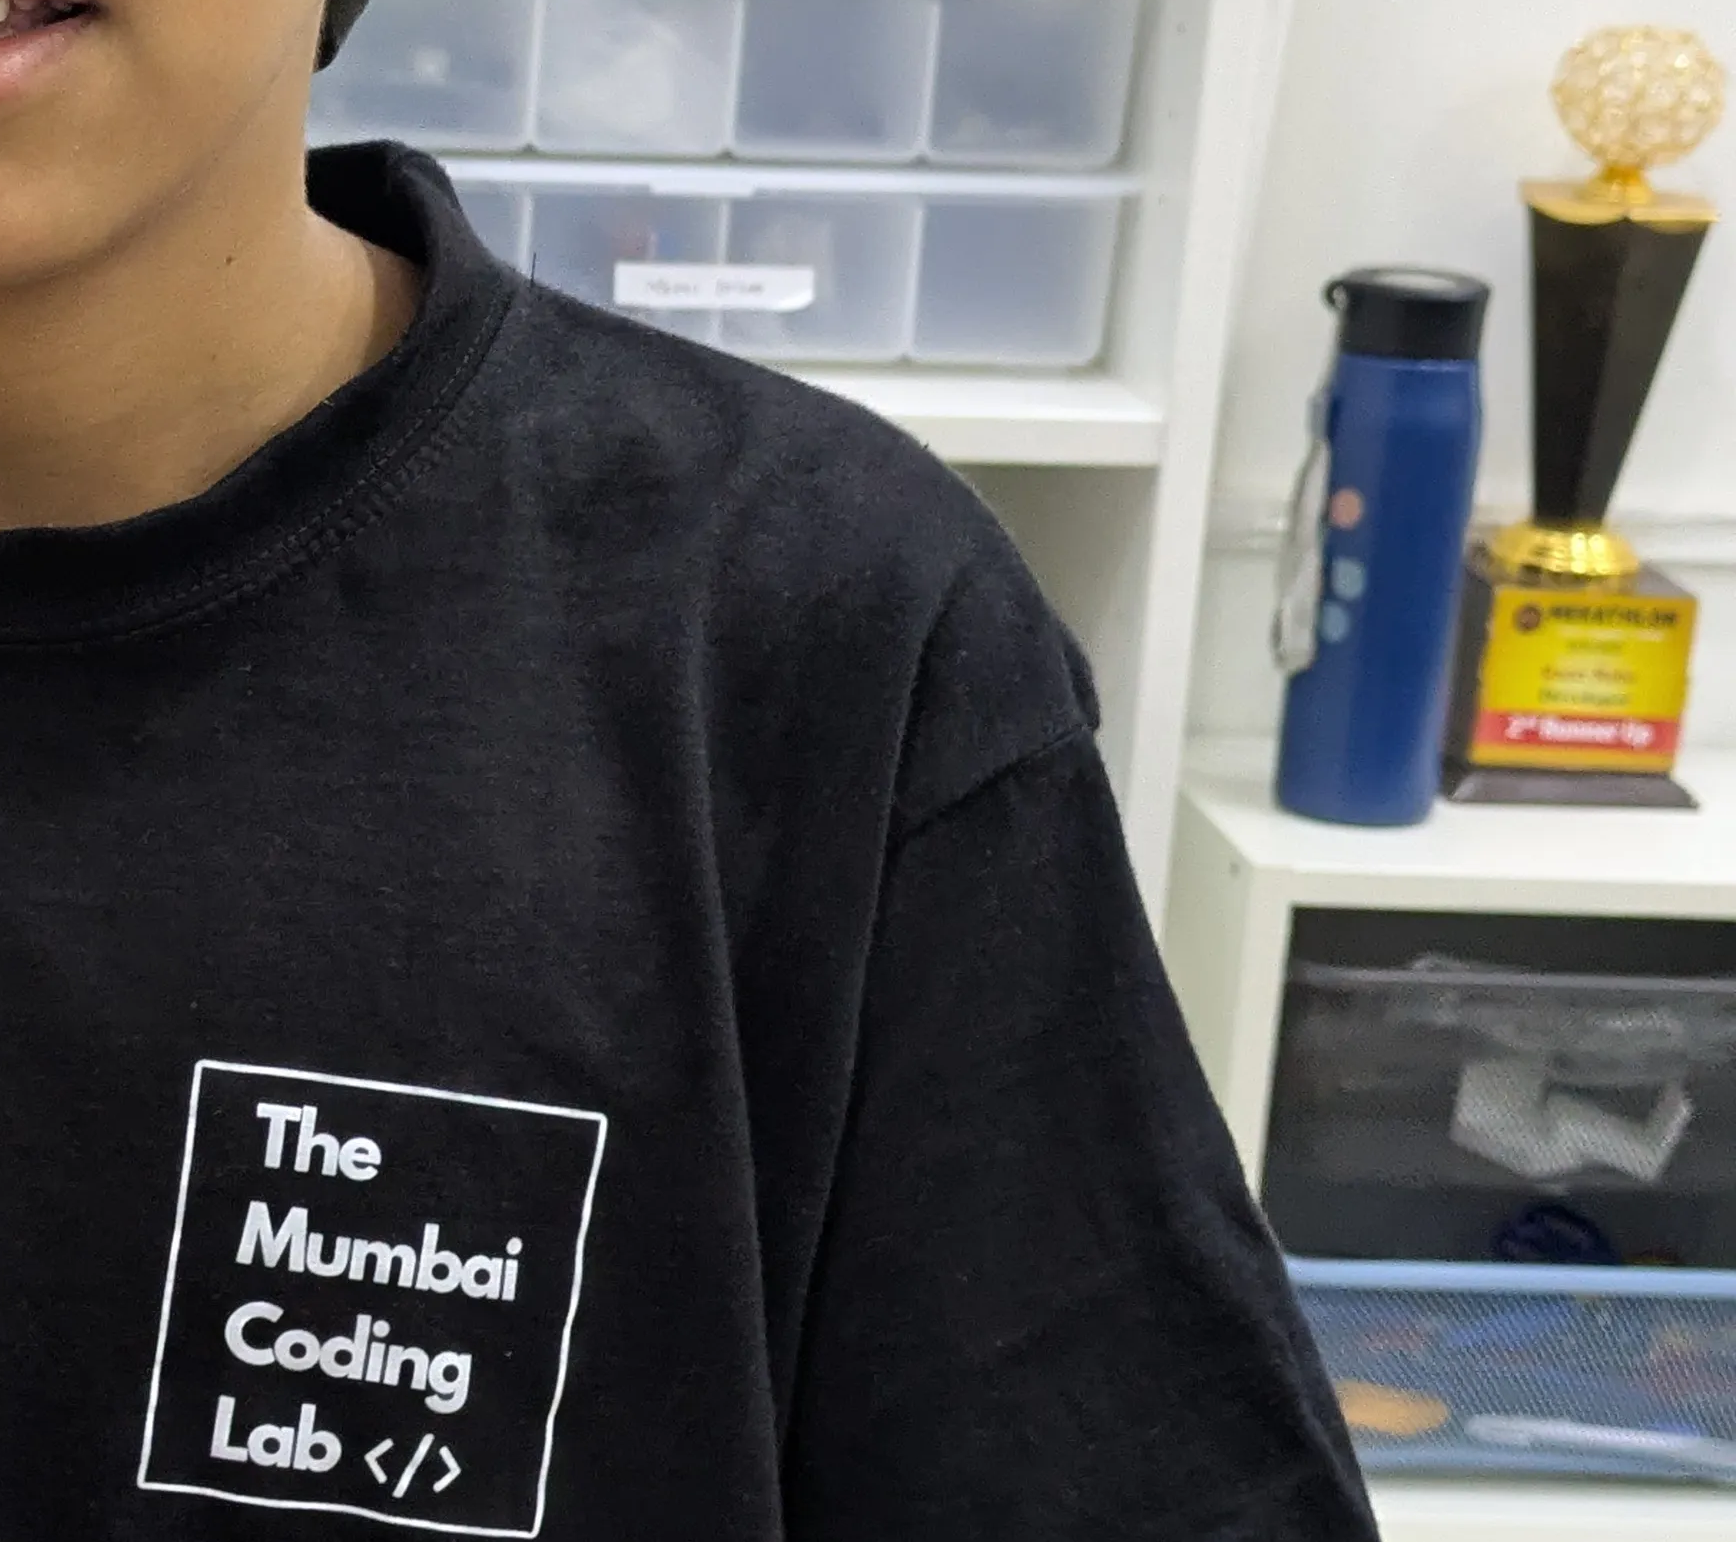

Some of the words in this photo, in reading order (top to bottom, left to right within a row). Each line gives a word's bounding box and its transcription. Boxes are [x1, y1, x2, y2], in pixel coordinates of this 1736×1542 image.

[256, 1102, 382, 1181] The
[235, 1201, 523, 1301] Mumbai
[224, 1301, 473, 1414] Coding
[210, 1395, 342, 1473] Lab
